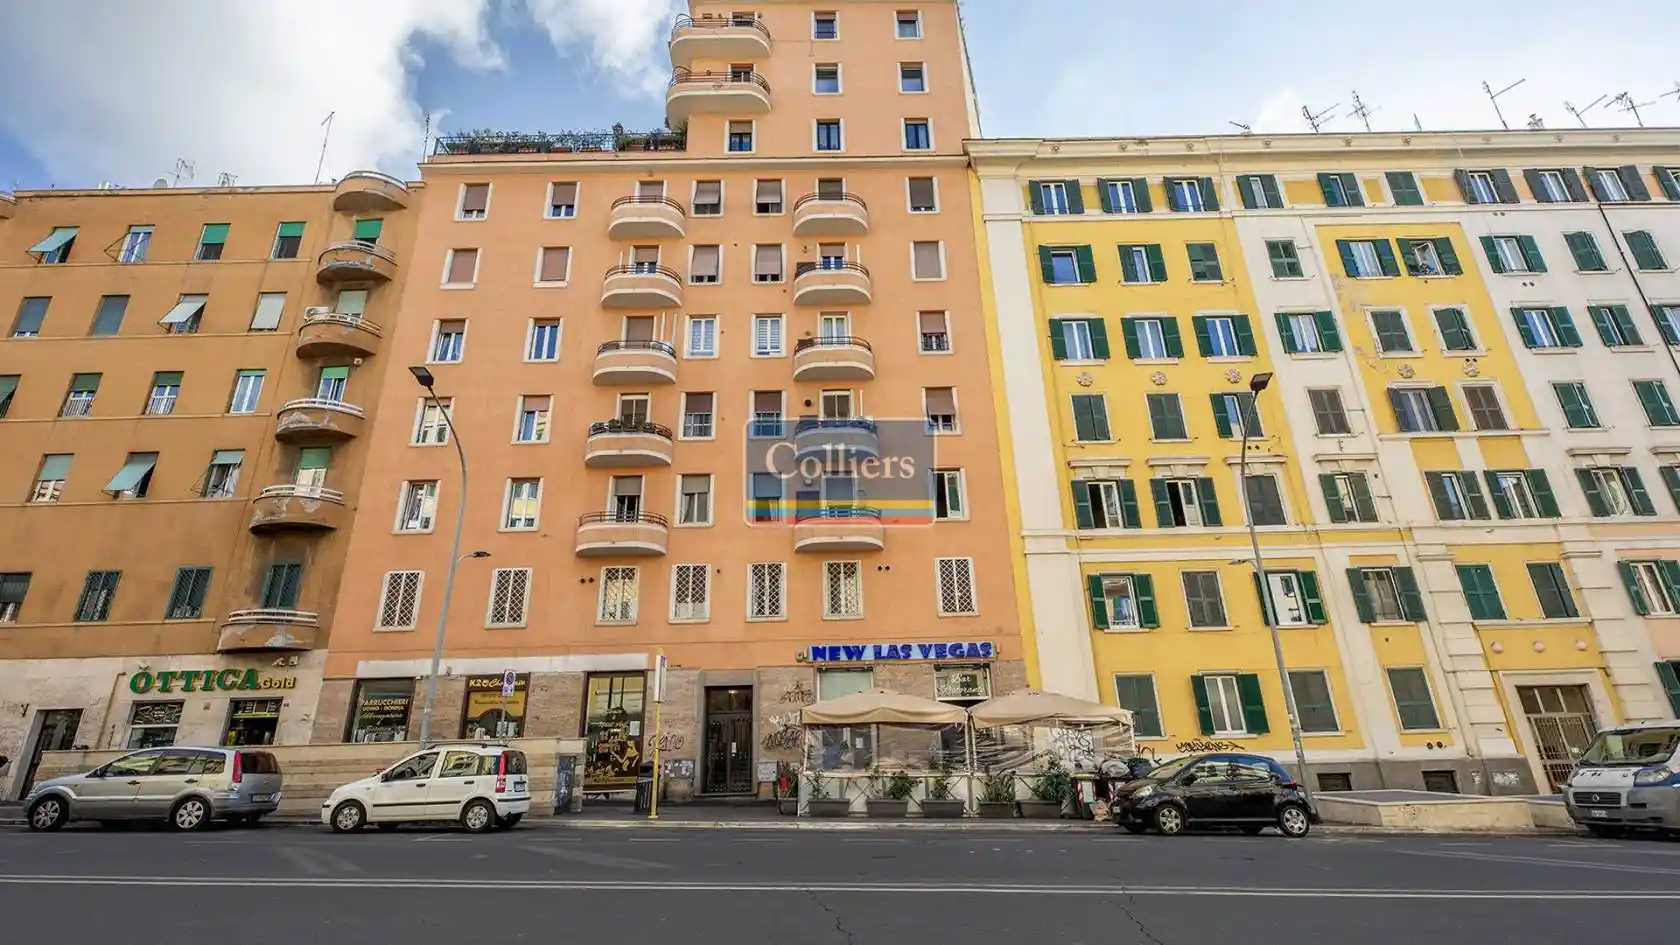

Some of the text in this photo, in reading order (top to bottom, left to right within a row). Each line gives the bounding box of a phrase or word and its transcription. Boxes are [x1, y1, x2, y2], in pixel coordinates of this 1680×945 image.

[811, 642, 992, 661] NEW LAS VEGAS
[129, 669, 296, 694] OTTICA Gold
